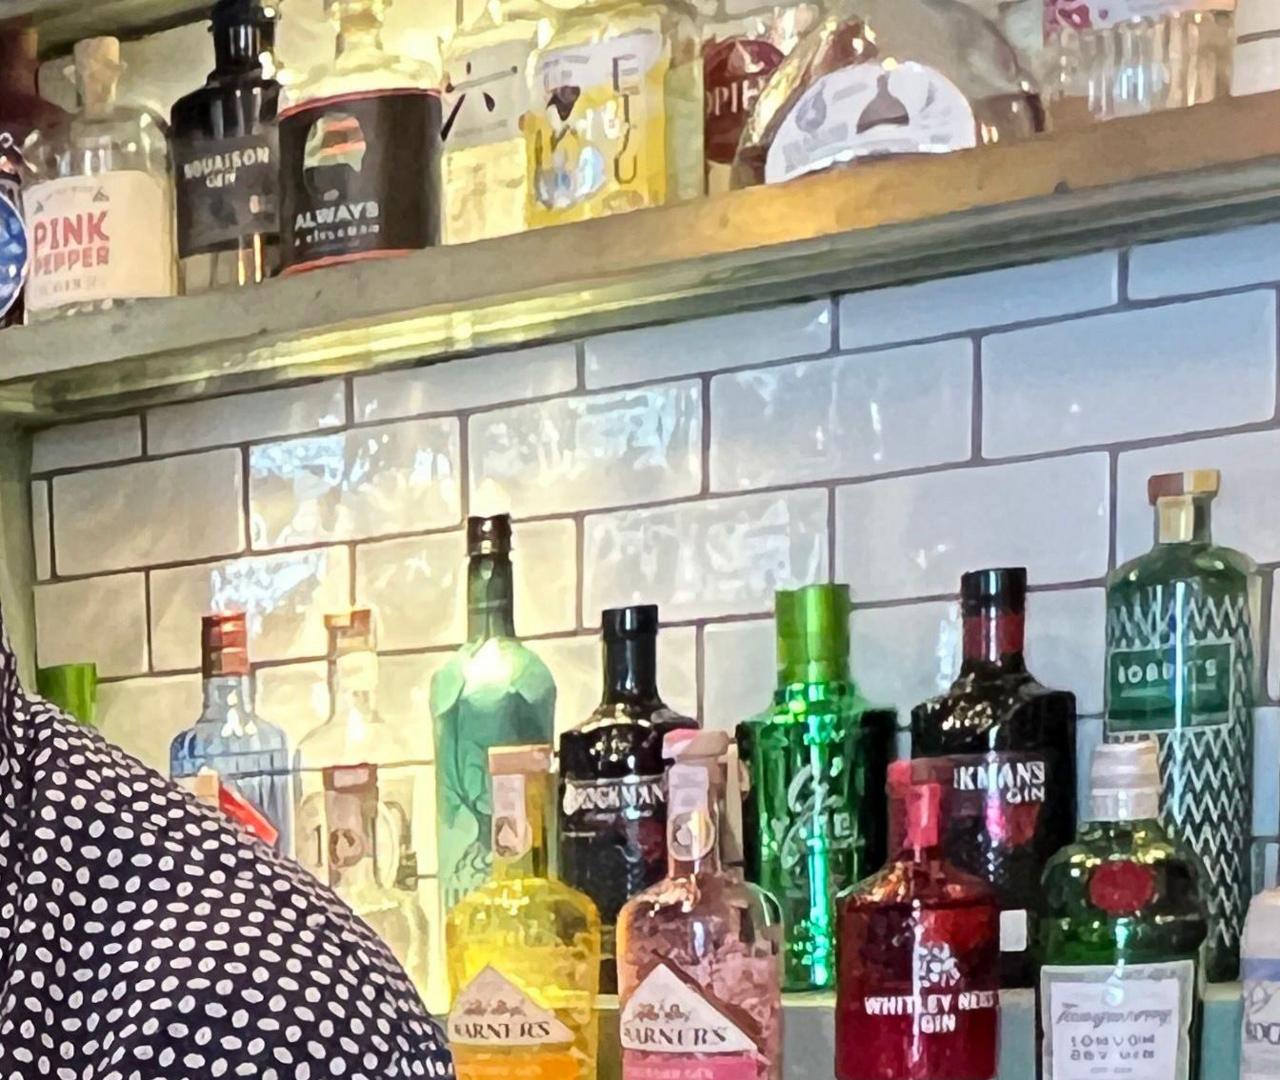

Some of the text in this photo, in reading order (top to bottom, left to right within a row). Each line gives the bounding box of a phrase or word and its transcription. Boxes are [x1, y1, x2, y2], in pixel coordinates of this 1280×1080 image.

[294, 200, 380, 231] ALWAYS
[33, 210, 111, 254] PINK
[33, 246, 111, 278] PEPPER
